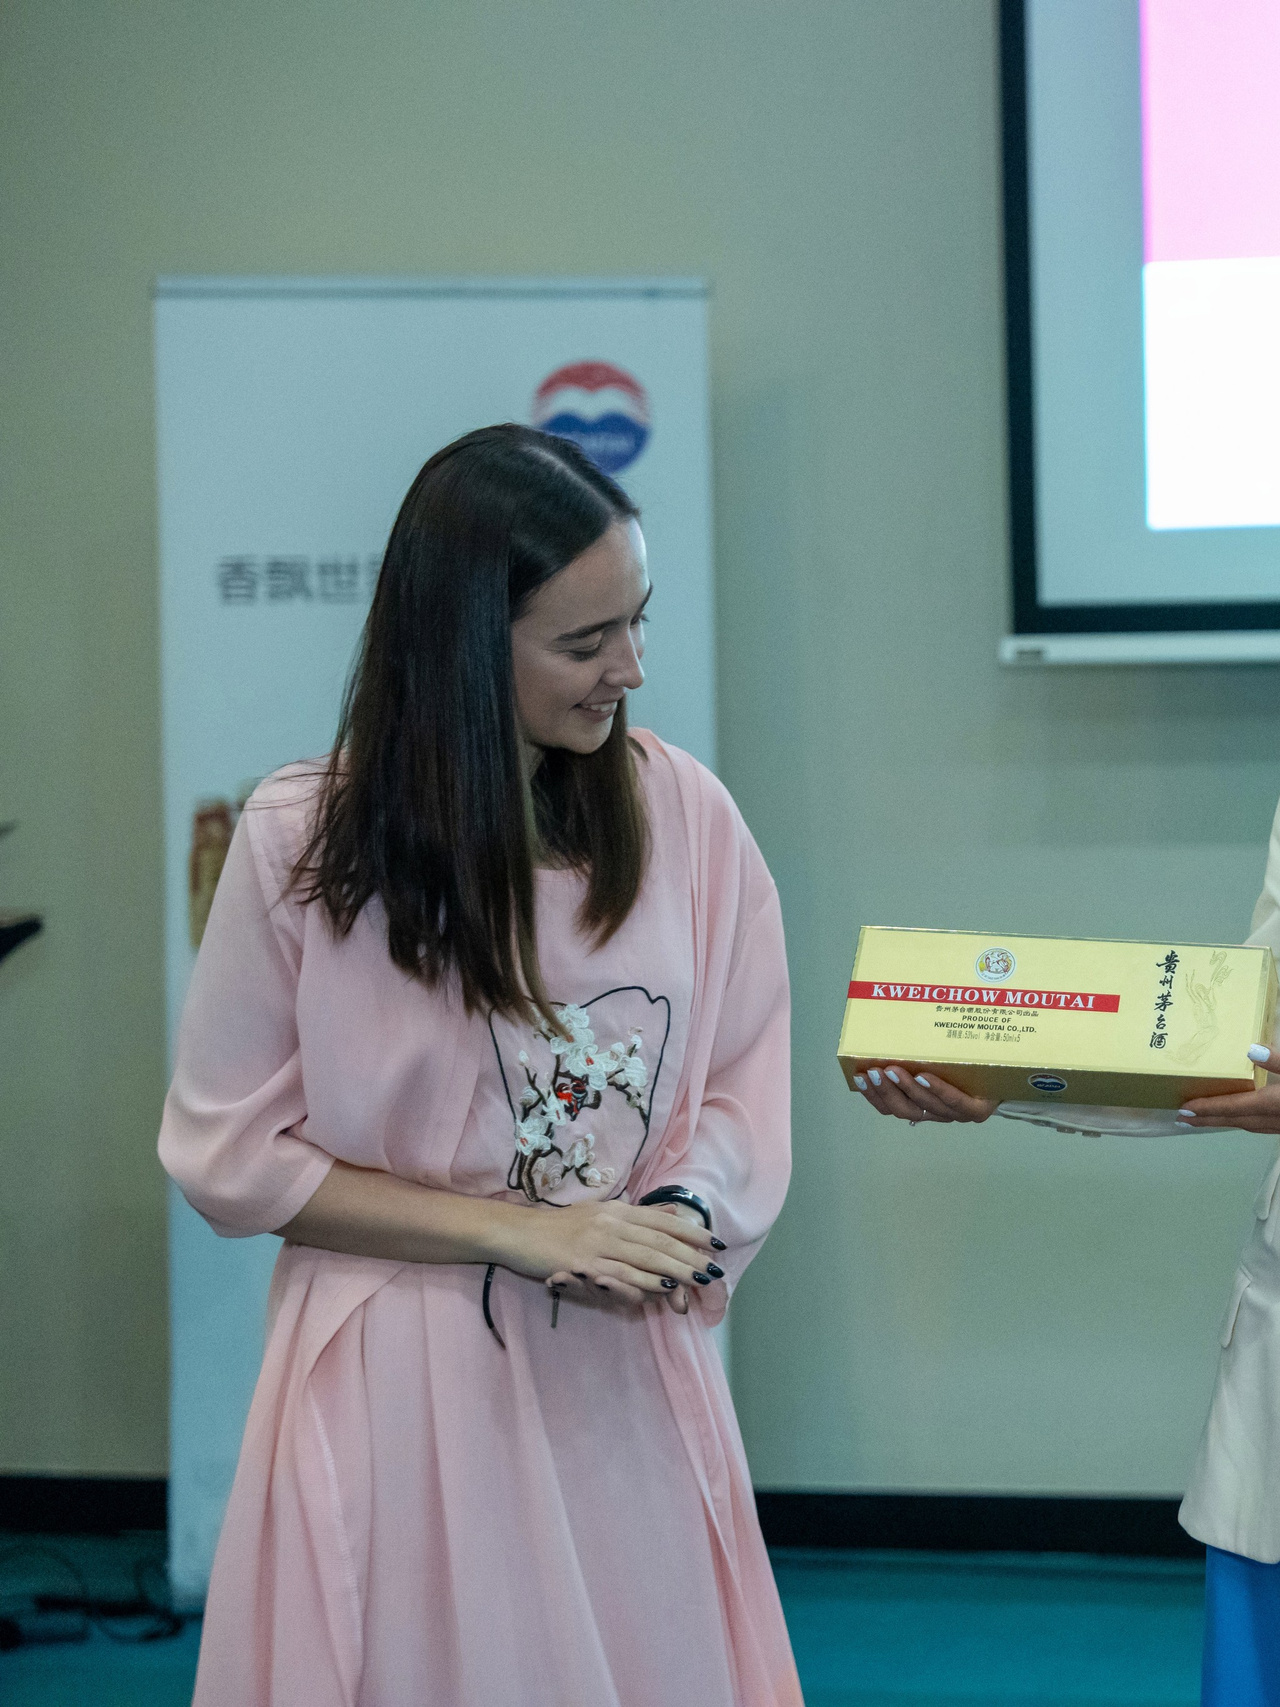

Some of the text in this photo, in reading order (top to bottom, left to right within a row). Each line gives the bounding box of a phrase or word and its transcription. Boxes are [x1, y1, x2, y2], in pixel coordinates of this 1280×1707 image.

[871, 984, 1095, 1009] KWEICHOW MOUTAI
[1149, 950, 1180, 1049] 贵州茅台酒
[934, 1021, 976, 1030] KWEICHOW
[977, 1023, 1005, 1031] MOUTAI
[962, 1015, 999, 1023] PRODUCE
